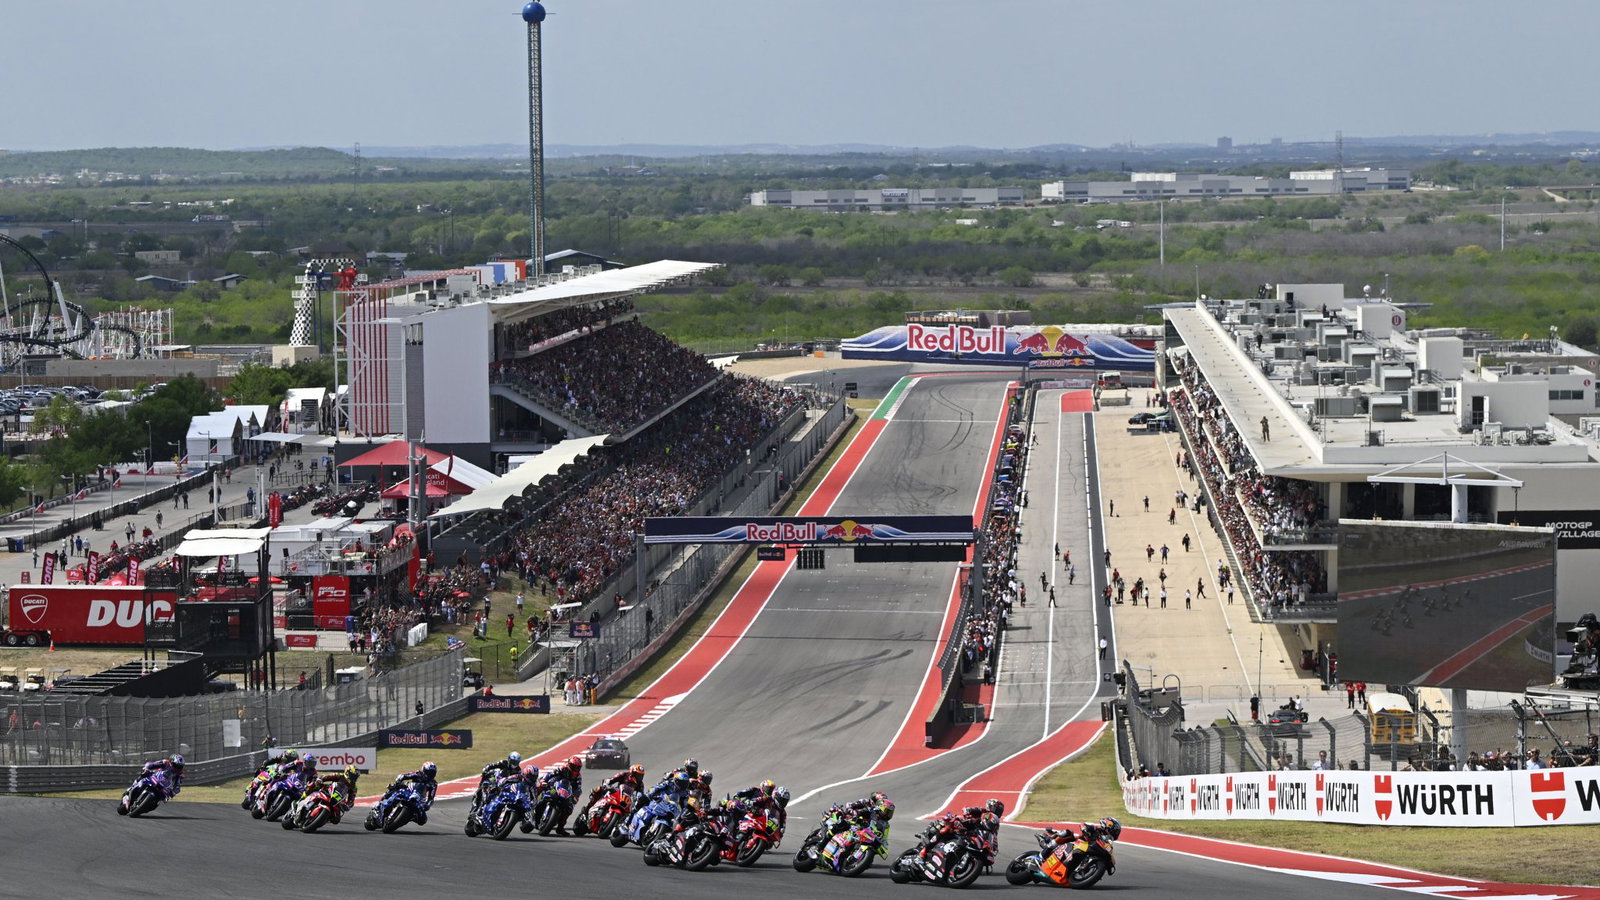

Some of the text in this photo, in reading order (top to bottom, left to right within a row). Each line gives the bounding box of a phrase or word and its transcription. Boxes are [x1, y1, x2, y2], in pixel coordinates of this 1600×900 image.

[907, 324, 1006, 354] Red Bull
[746, 522, 817, 541] Red Bull
[1545, 521, 1593, 529] MOTOGP
[87, 600, 176, 628] DUC
[477, 698, 511, 709] Red Bull
[388, 733, 427, 745] Red Bull
[1397, 784, 1495, 815] WÜRTH
